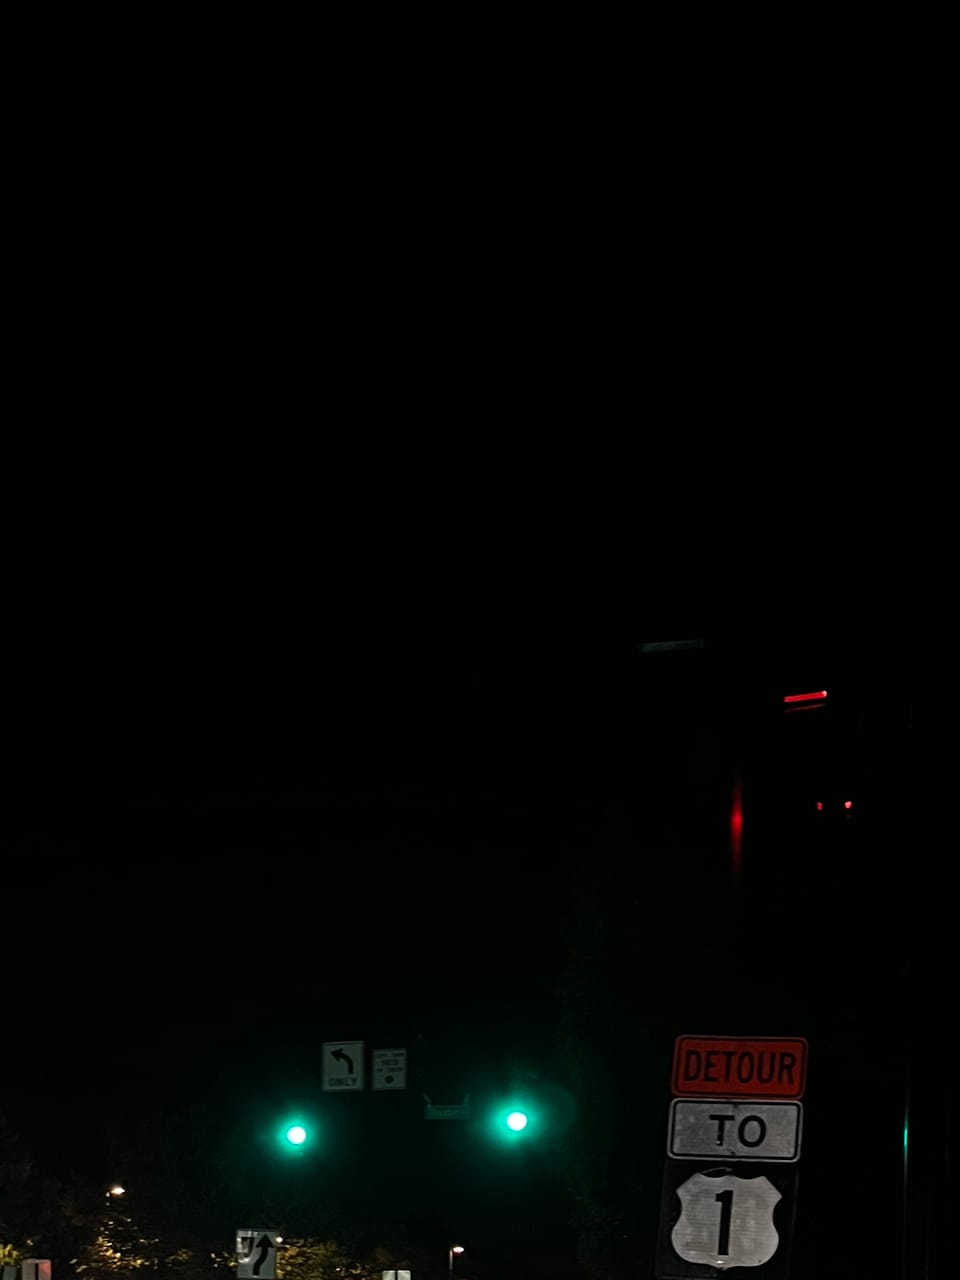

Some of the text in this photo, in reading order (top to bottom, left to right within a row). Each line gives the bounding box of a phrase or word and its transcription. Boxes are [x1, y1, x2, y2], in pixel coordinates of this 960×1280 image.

[683, 1048, 797, 1086] DETOUR
[710, 1114, 767, 1148] TO
[715, 1190, 734, 1256] 1
